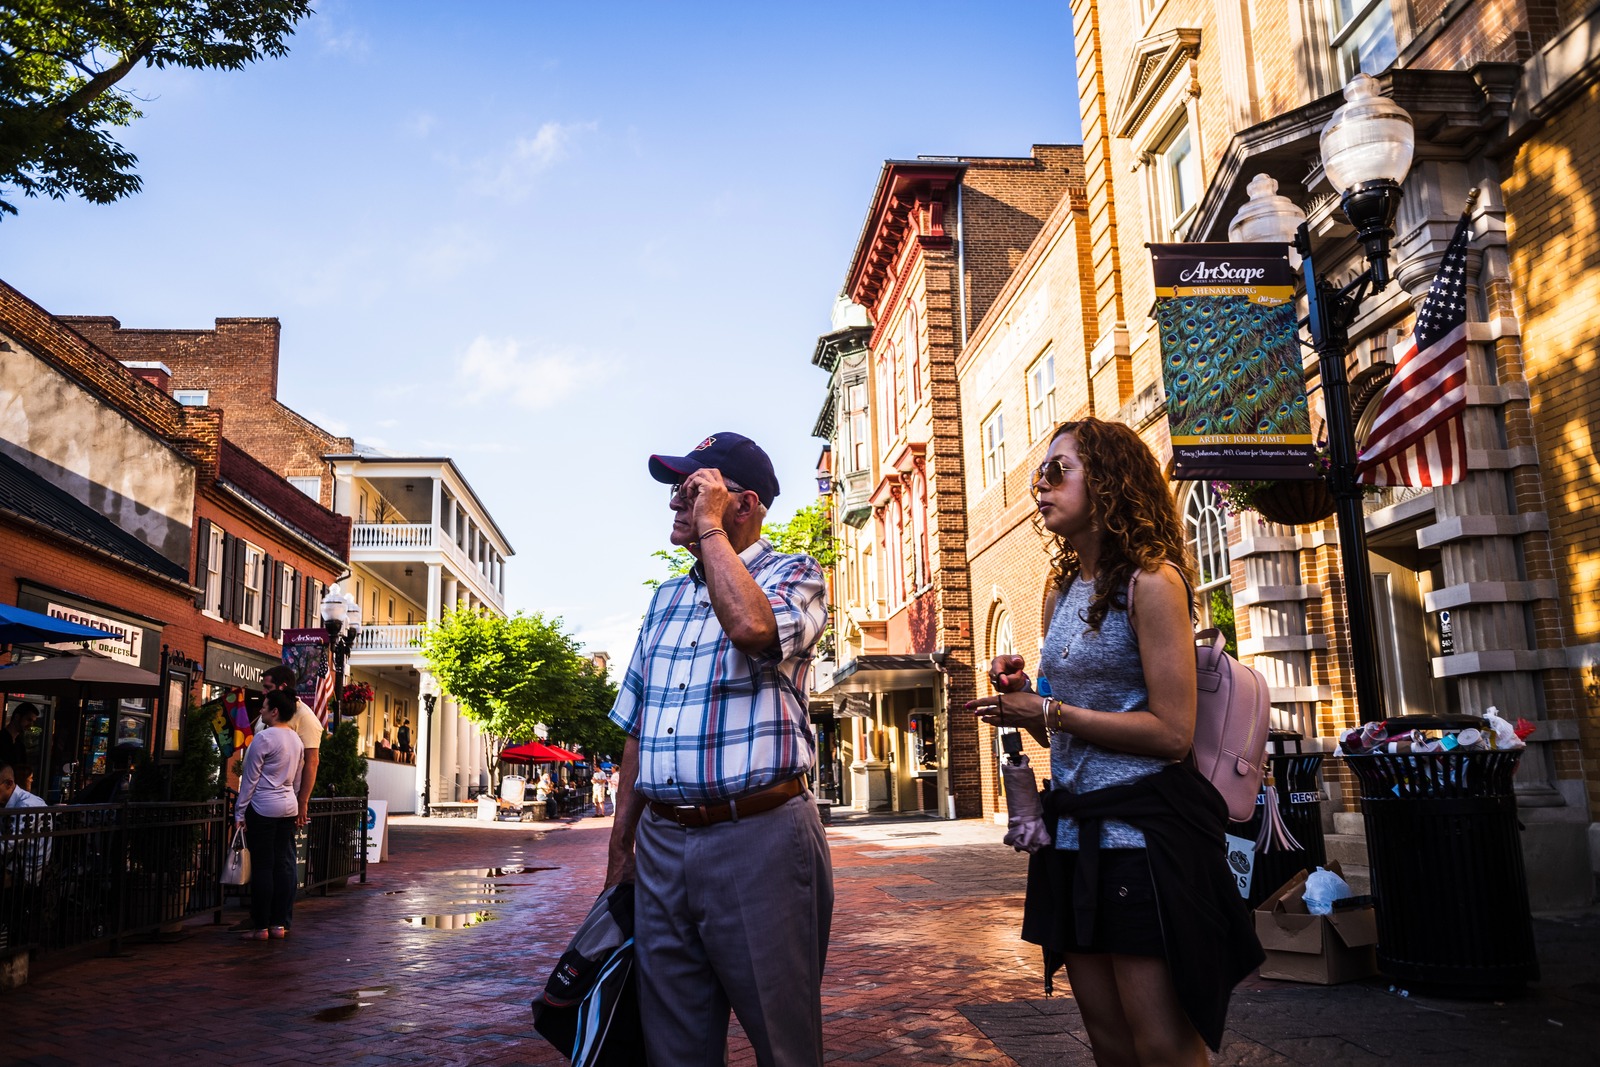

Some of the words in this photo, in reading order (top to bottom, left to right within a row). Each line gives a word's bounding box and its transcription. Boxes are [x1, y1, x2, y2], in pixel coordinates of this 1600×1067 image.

[1180, 261, 1265, 284] ArtScape
[1192, 287, 1257, 295] SHENARTS.ORG
[1234, 436, 1257, 444] JOHN
[1179, 449, 1195, 459] Tracy
[1250, 449, 1258, 458] for
[98, 643, 129, 656] OBJECTS
